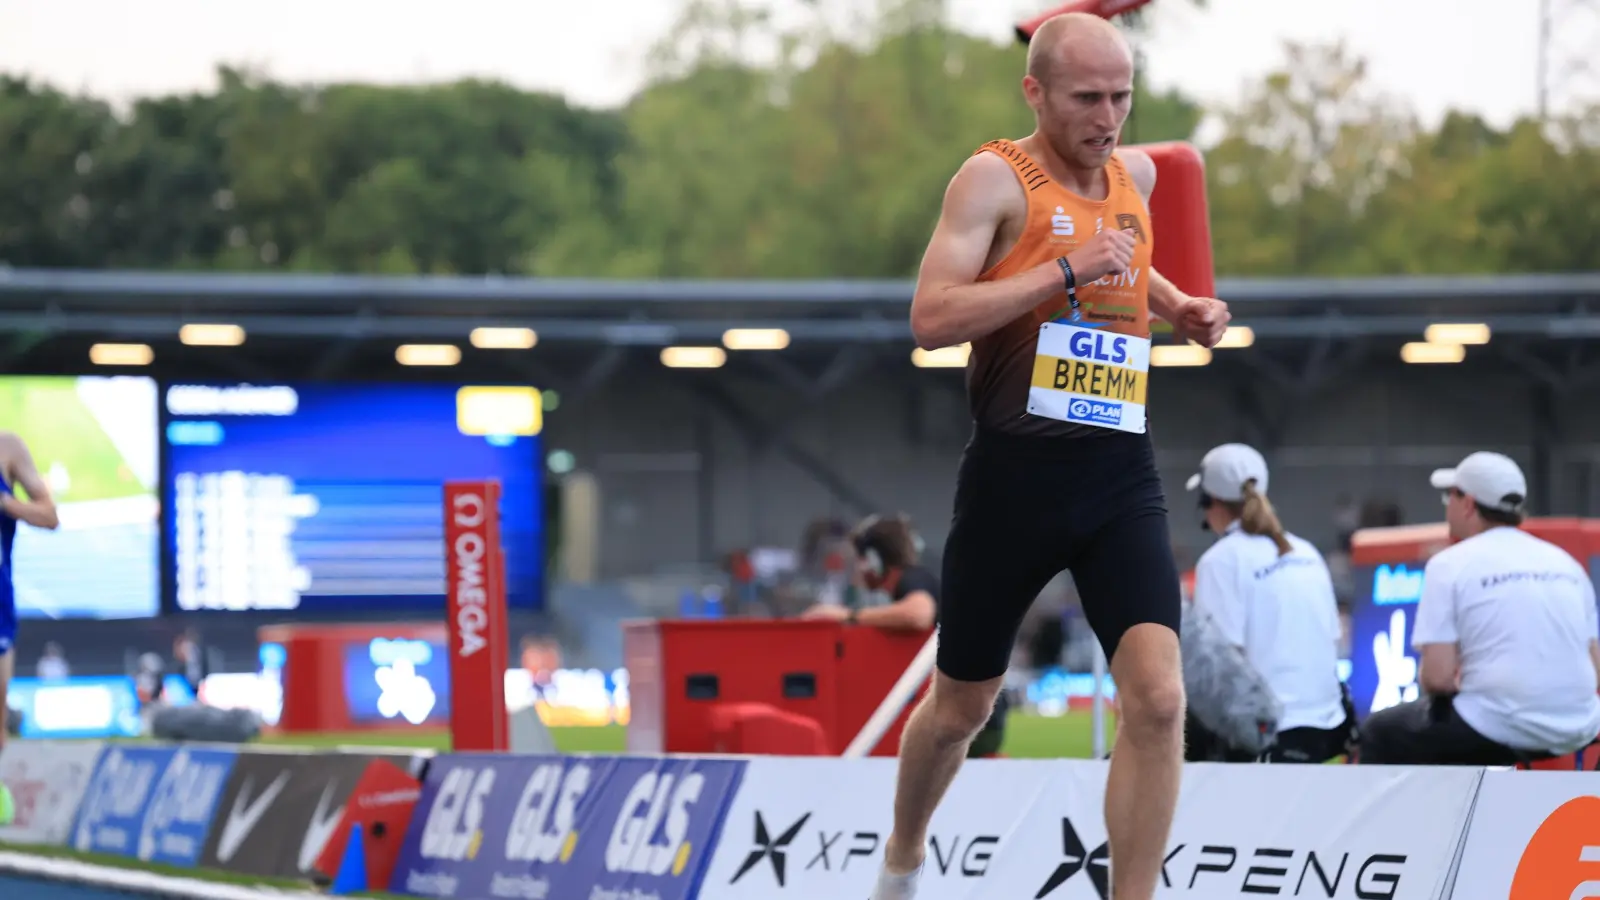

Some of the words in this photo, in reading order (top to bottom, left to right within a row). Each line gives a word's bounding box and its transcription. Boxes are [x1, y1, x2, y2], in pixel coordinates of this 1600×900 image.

[1053, 358, 1137, 401] BREMM
[1092, 404, 1121, 419] PLAN
[454, 532, 488, 657] OMEGA
[804, 830, 1000, 878] XPNG
